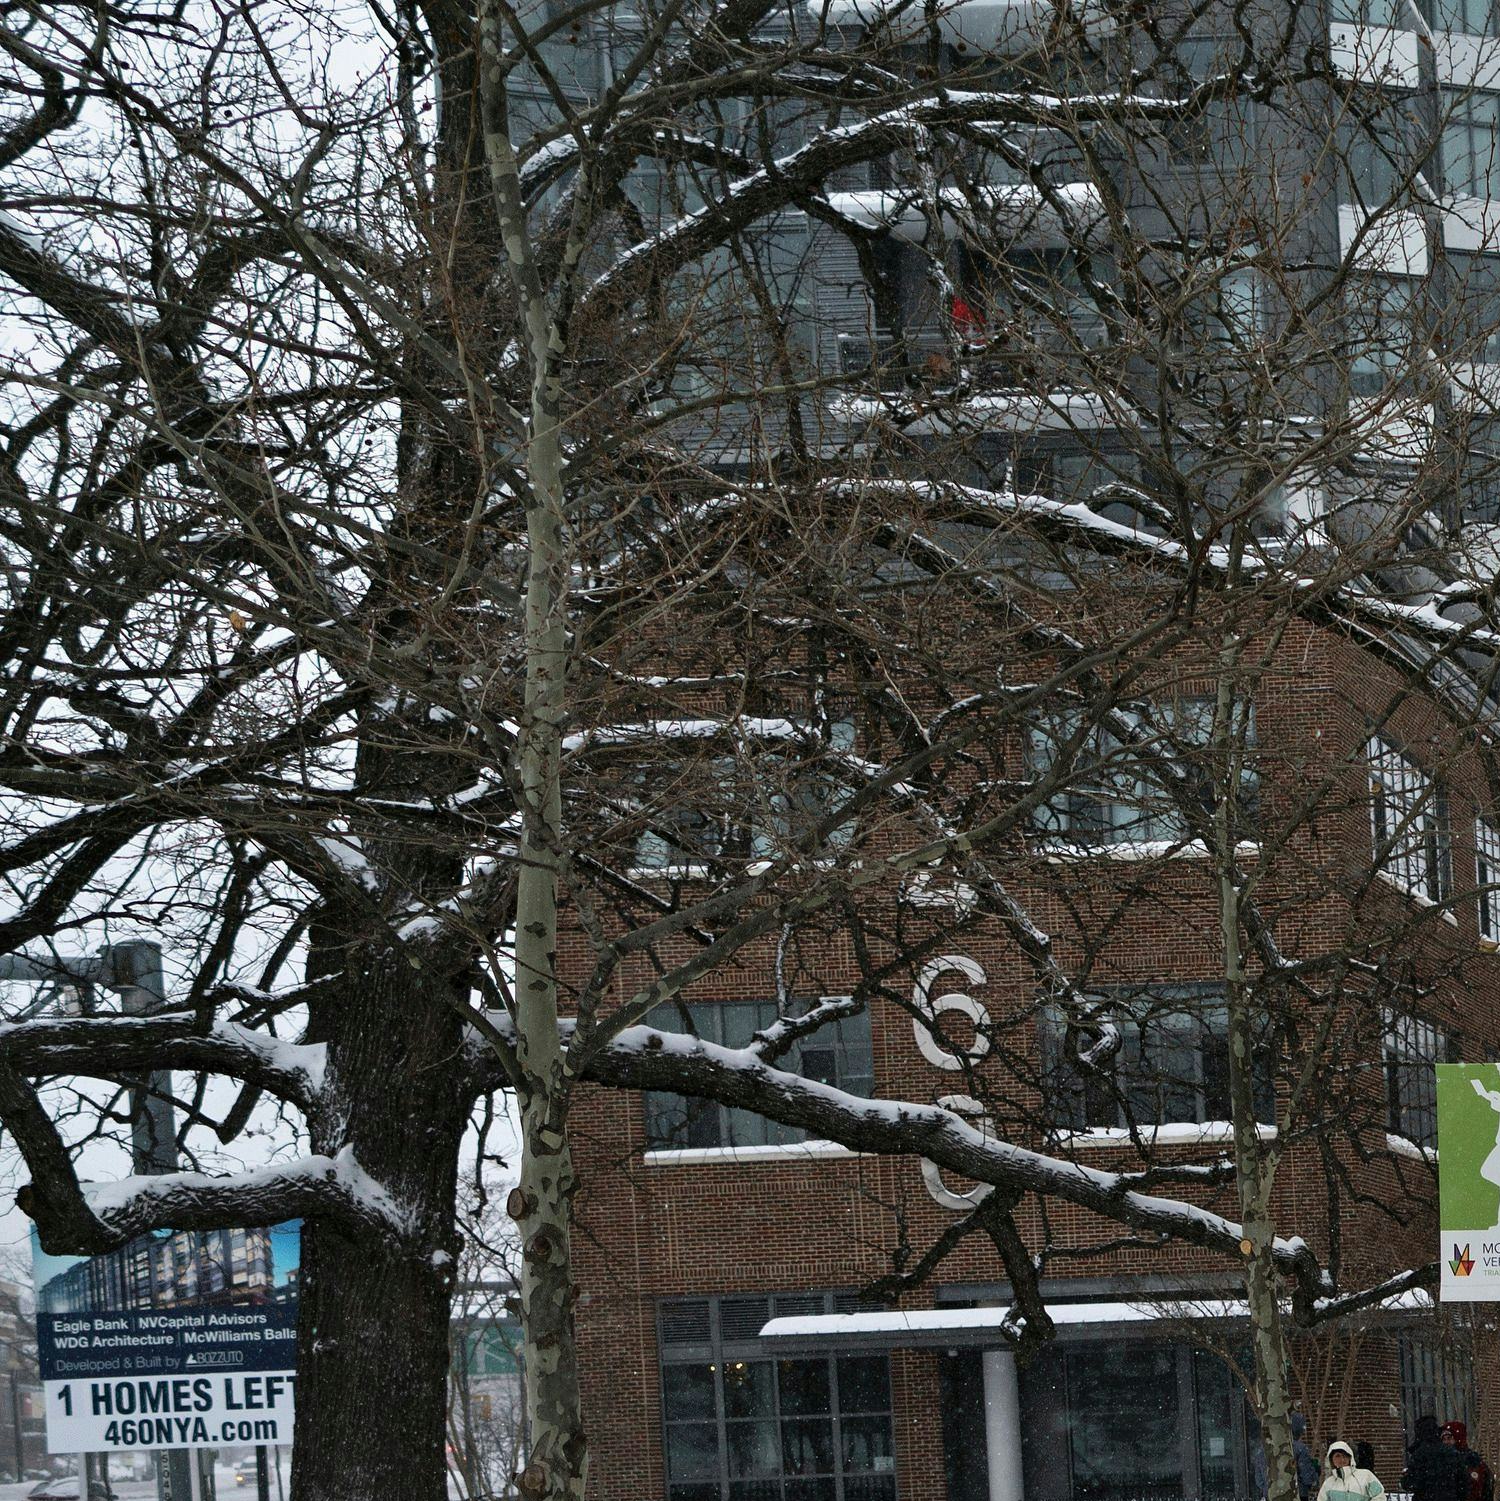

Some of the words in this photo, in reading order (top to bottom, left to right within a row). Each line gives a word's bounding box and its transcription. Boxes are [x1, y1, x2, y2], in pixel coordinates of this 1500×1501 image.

[53, 1320, 91, 1334] Eagle
[95, 1318, 129, 1331] Bank
[208, 1313, 267, 1326] Advisors
[54, 1336, 89, 1349] WDG
[92, 1333, 174, 1348] Architecture
[184, 1330, 261, 1344] McWilliams
[56, 1358, 121, 1373] Developed
[124, 1357, 135, 1369] &
[136, 1356, 162, 1369] Built
[166, 1356, 181, 1371] by
[57, 1383, 74, 1418] 1
[91, 1378, 213, 1416] HOMES
[104, 1416, 279, 1446] 460NYA.com
